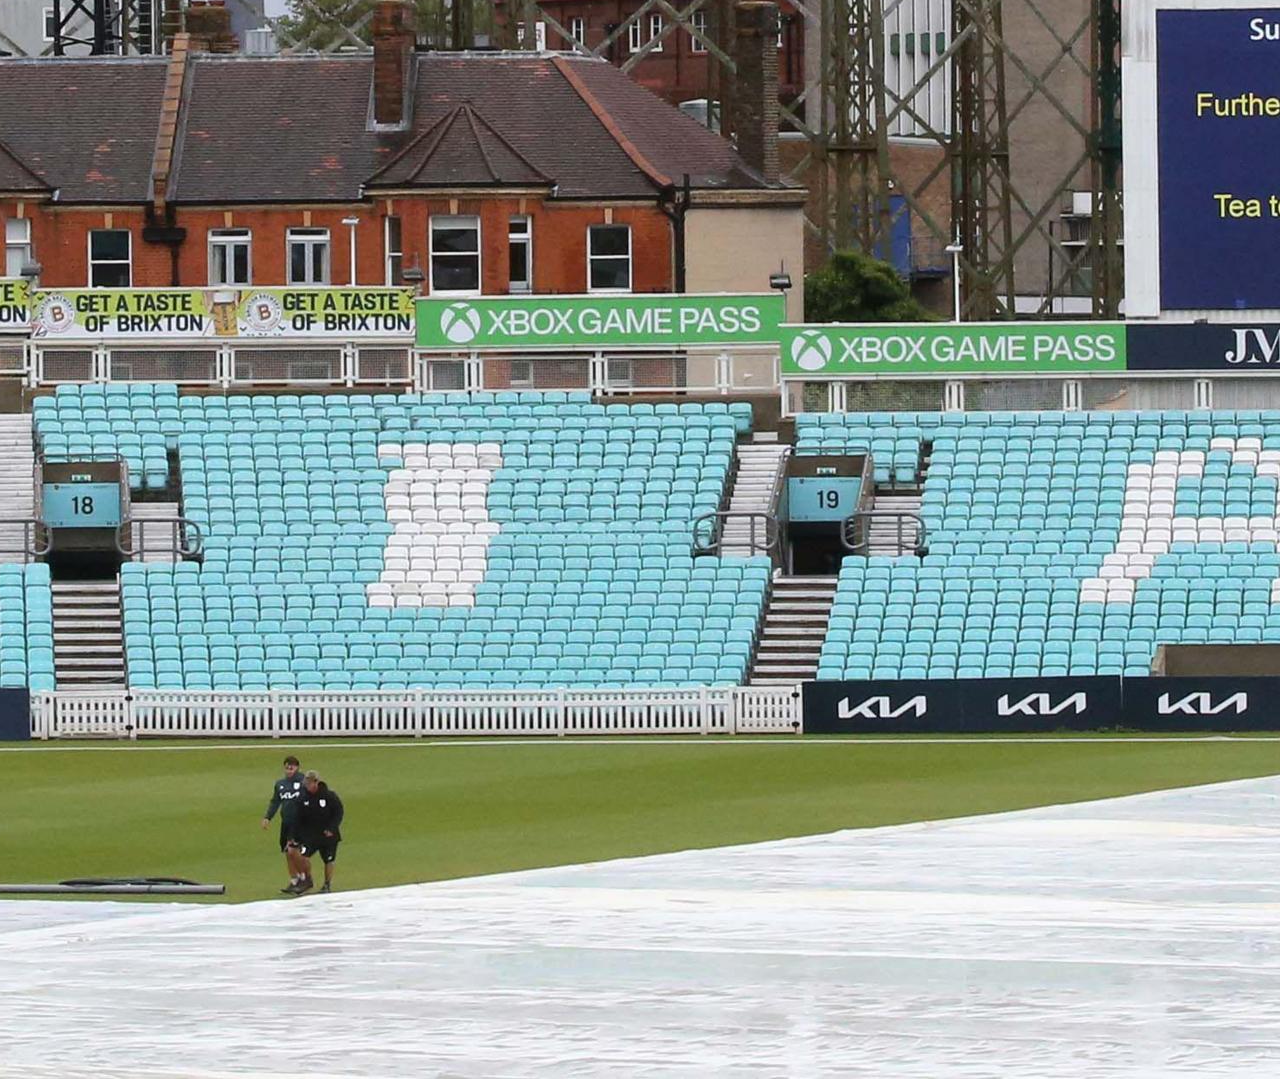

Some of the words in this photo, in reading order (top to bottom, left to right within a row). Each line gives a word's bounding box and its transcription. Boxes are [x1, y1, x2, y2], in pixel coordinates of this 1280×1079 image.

[1213, 194, 1261, 218] Tea
[75, 294, 112, 313] GET
[115, 294, 129, 312] A
[132, 293, 192, 312] TASTE
[282, 292, 319, 311] GET
[322, 292, 337, 311] A
[339, 292, 400, 311] TASTE
[84, 314, 111, 333] OF
[116, 313, 203, 332] BRIXTON
[291, 313, 318, 331] OF
[324, 312, 411, 331] BRIXTON
[487, 308, 575, 335] XBOX
[577, 308, 673, 335] GAME
[679, 306, 761, 333] PASS
[839, 336, 927, 363] XBOX
[930, 335, 1027, 362] GAME
[1033, 334, 1116, 361] PASS
[71, 496, 94, 515] 18
[816, 490, 839, 509] 19
